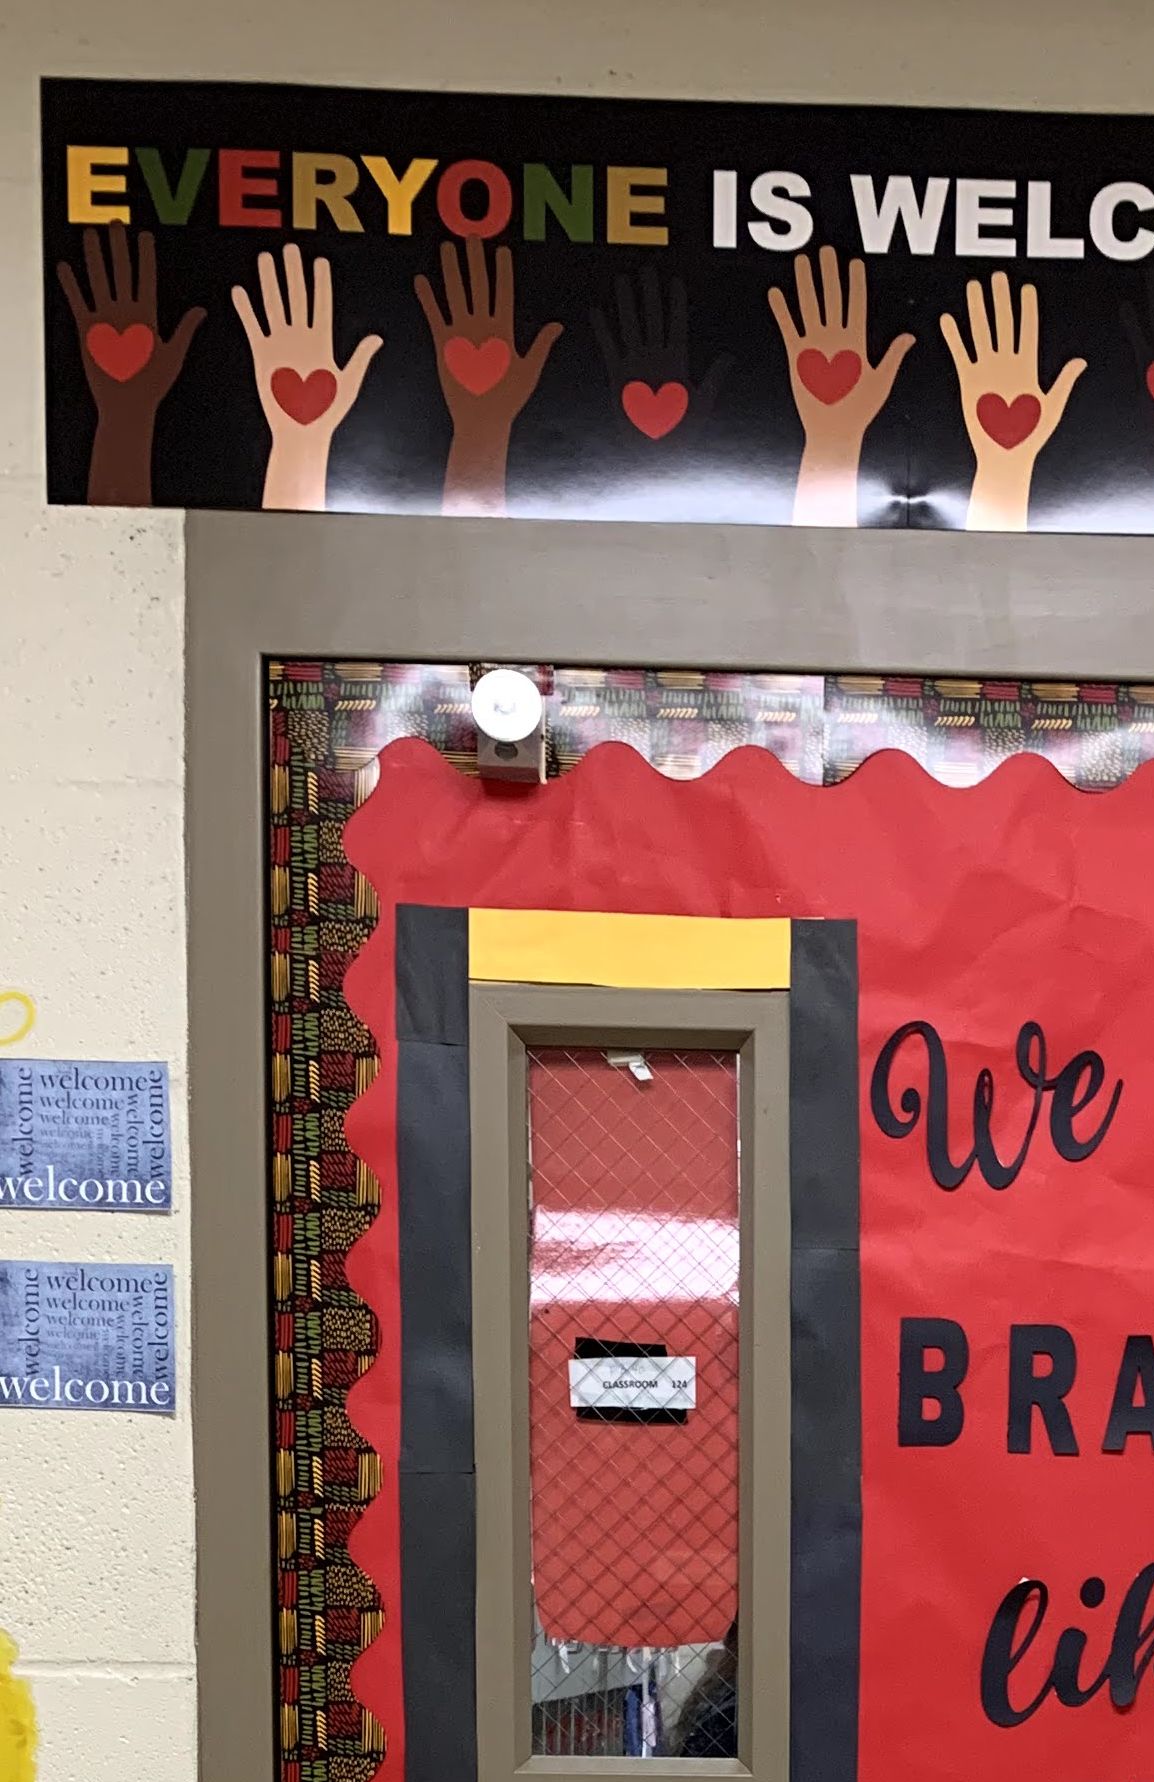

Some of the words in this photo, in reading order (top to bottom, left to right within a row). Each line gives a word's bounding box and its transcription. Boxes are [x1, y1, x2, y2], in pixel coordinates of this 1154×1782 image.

[67, 145, 668, 246] EVERYONE
[712, 169, 814, 253] IS
[40, 1067, 148, 1091] welcome
[40, 1092, 124, 1110] welcome
[40, 1111, 109, 1125] welcome
[870, 1020, 1123, 1191] We
[12, 1067, 34, 1176] welcome
[143, 1070, 165, 1180] welcome
[0, 1165, 166, 1204] welcome
[47, 1269, 153, 1293] welcome
[46, 1292, 129, 1311] welcome
[47, 1312, 115, 1327] welcome
[18, 1268, 40, 1376] welcome
[147, 1272, 169, 1380] welcome
[0, 1365, 170, 1405] welcome
[603, 1380, 658, 1389] CLASSROOM
